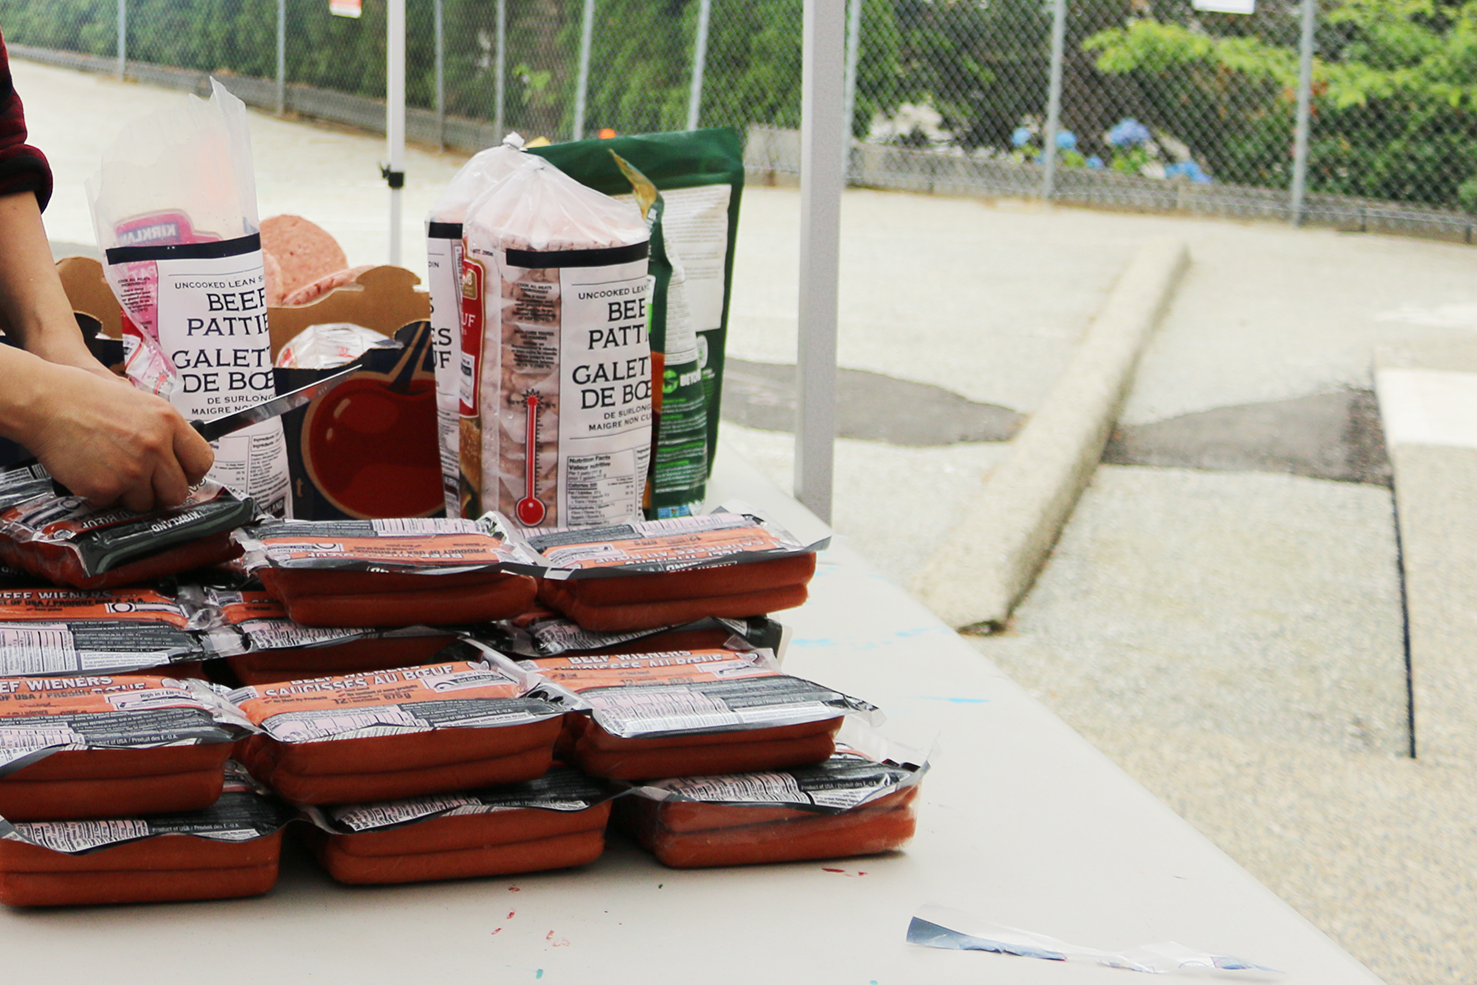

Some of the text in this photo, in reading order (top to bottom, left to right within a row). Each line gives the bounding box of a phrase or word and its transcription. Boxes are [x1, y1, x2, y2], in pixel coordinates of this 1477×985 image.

[175, 280, 226, 290] UNCOOKED
[229, 278, 256, 288] LEAN
[578, 288, 630, 300] UNCOOKED
[608, 298, 646, 322] BEE
[187, 313, 270, 337] PATTIE
[572, 356, 649, 385] GALET
[182, 372, 220, 393] DE
[207, 394, 274, 405] DE SURLONG
[581, 387, 616, 409] DE
[191, 405, 231, 415] MAIGRE
[604, 404, 652, 420] DE SURLONG
[589, 420, 622, 431] MAIGRE
[624, 416, 639, 426] NON
[26, 676, 113, 692] WIENERS
[265, 678, 368, 696] SAUCISSES
[374, 673, 398, 685] AU
[14, 692, 35, 700] USA
